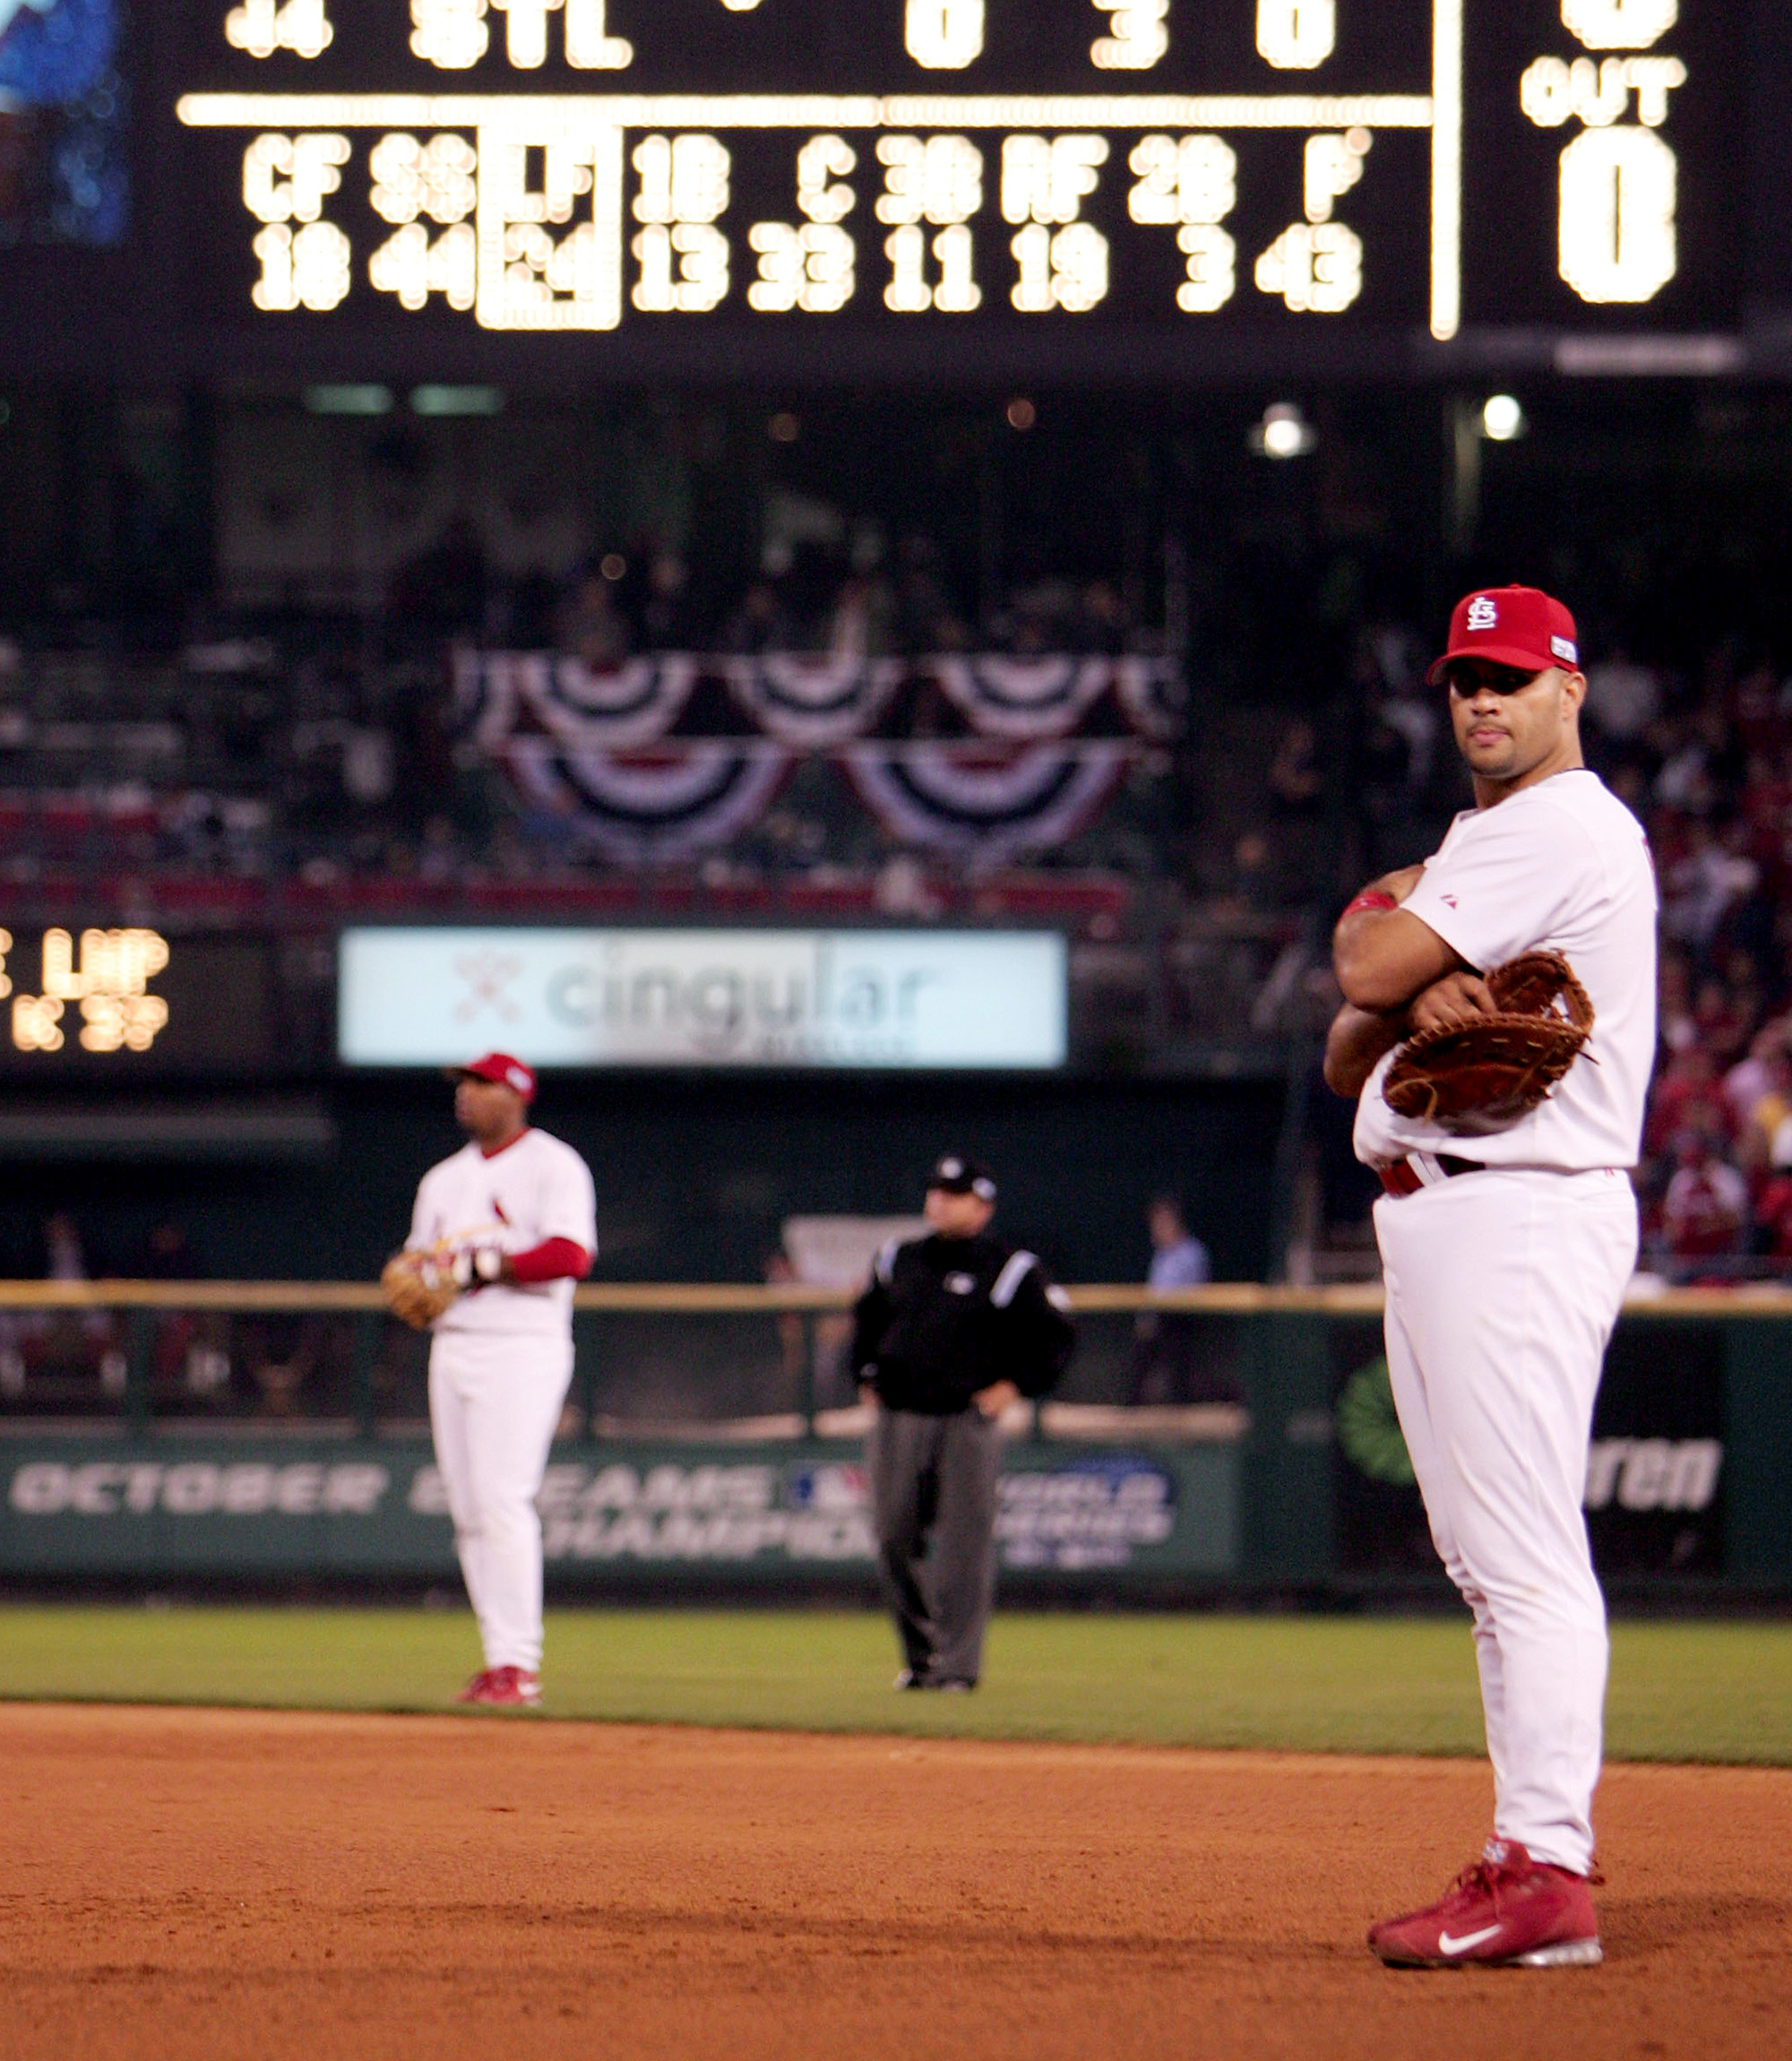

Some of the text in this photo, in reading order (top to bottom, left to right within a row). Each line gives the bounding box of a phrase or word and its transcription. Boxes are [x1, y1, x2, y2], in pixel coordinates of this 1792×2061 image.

[409, 0, 633, 69] STL
[1521, 56, 1686, 126] OUT
[243, 134, 351, 222] CF
[797, 134, 856, 222] C
[1001, 134, 1109, 223] RF
[1558, 125, 1676, 303] 0
[369, 223, 476, 310] 44
[632, 223, 729, 311] 13
[748, 222, 855, 312] 33
[884, 224, 981, 311] 11
[1176, 224, 1236, 312] 3
[1255, 223, 1362, 312] 43
[545, 936, 937, 1054] cingular
[11, 1462, 389, 1514] OCTOBER
